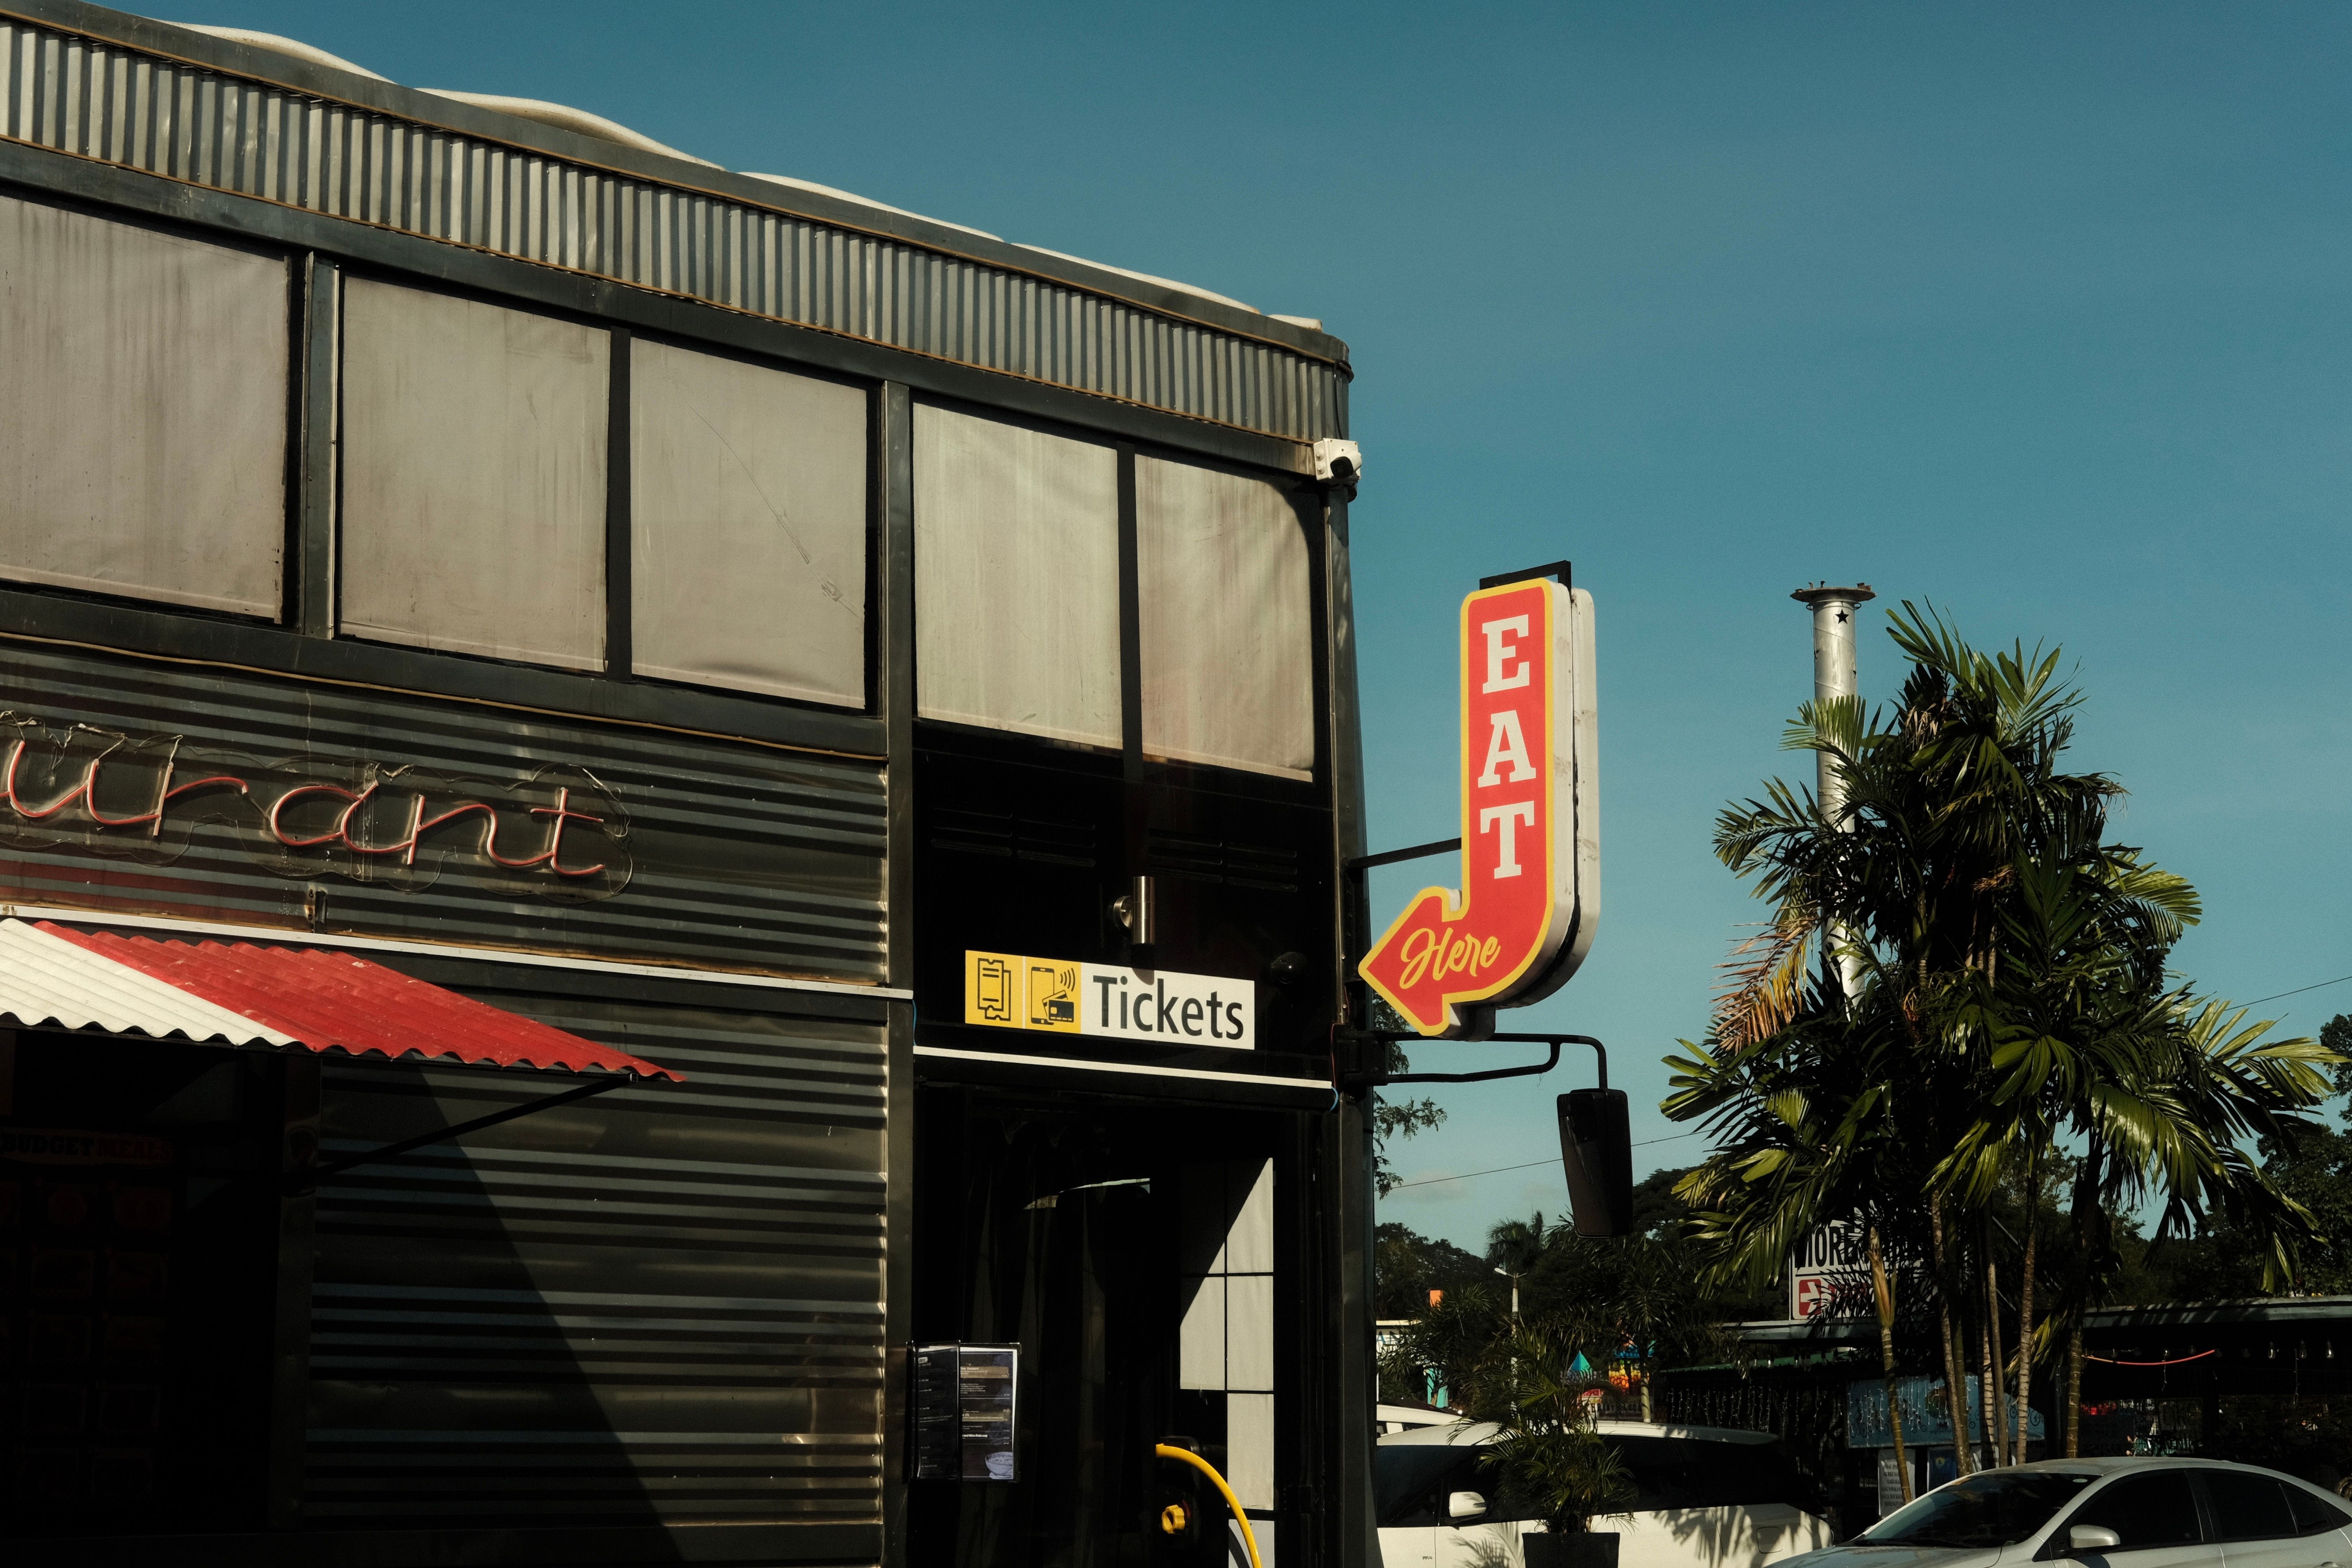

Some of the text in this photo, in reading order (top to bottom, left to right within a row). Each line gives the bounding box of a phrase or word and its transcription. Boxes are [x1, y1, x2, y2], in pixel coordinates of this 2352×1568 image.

[1477, 614, 1536, 879] EAT
[1399, 927, 1501, 989] Here
[1093, 975, 1244, 1040] Tickets
[1, 1133, 94, 1156] BUDGET
